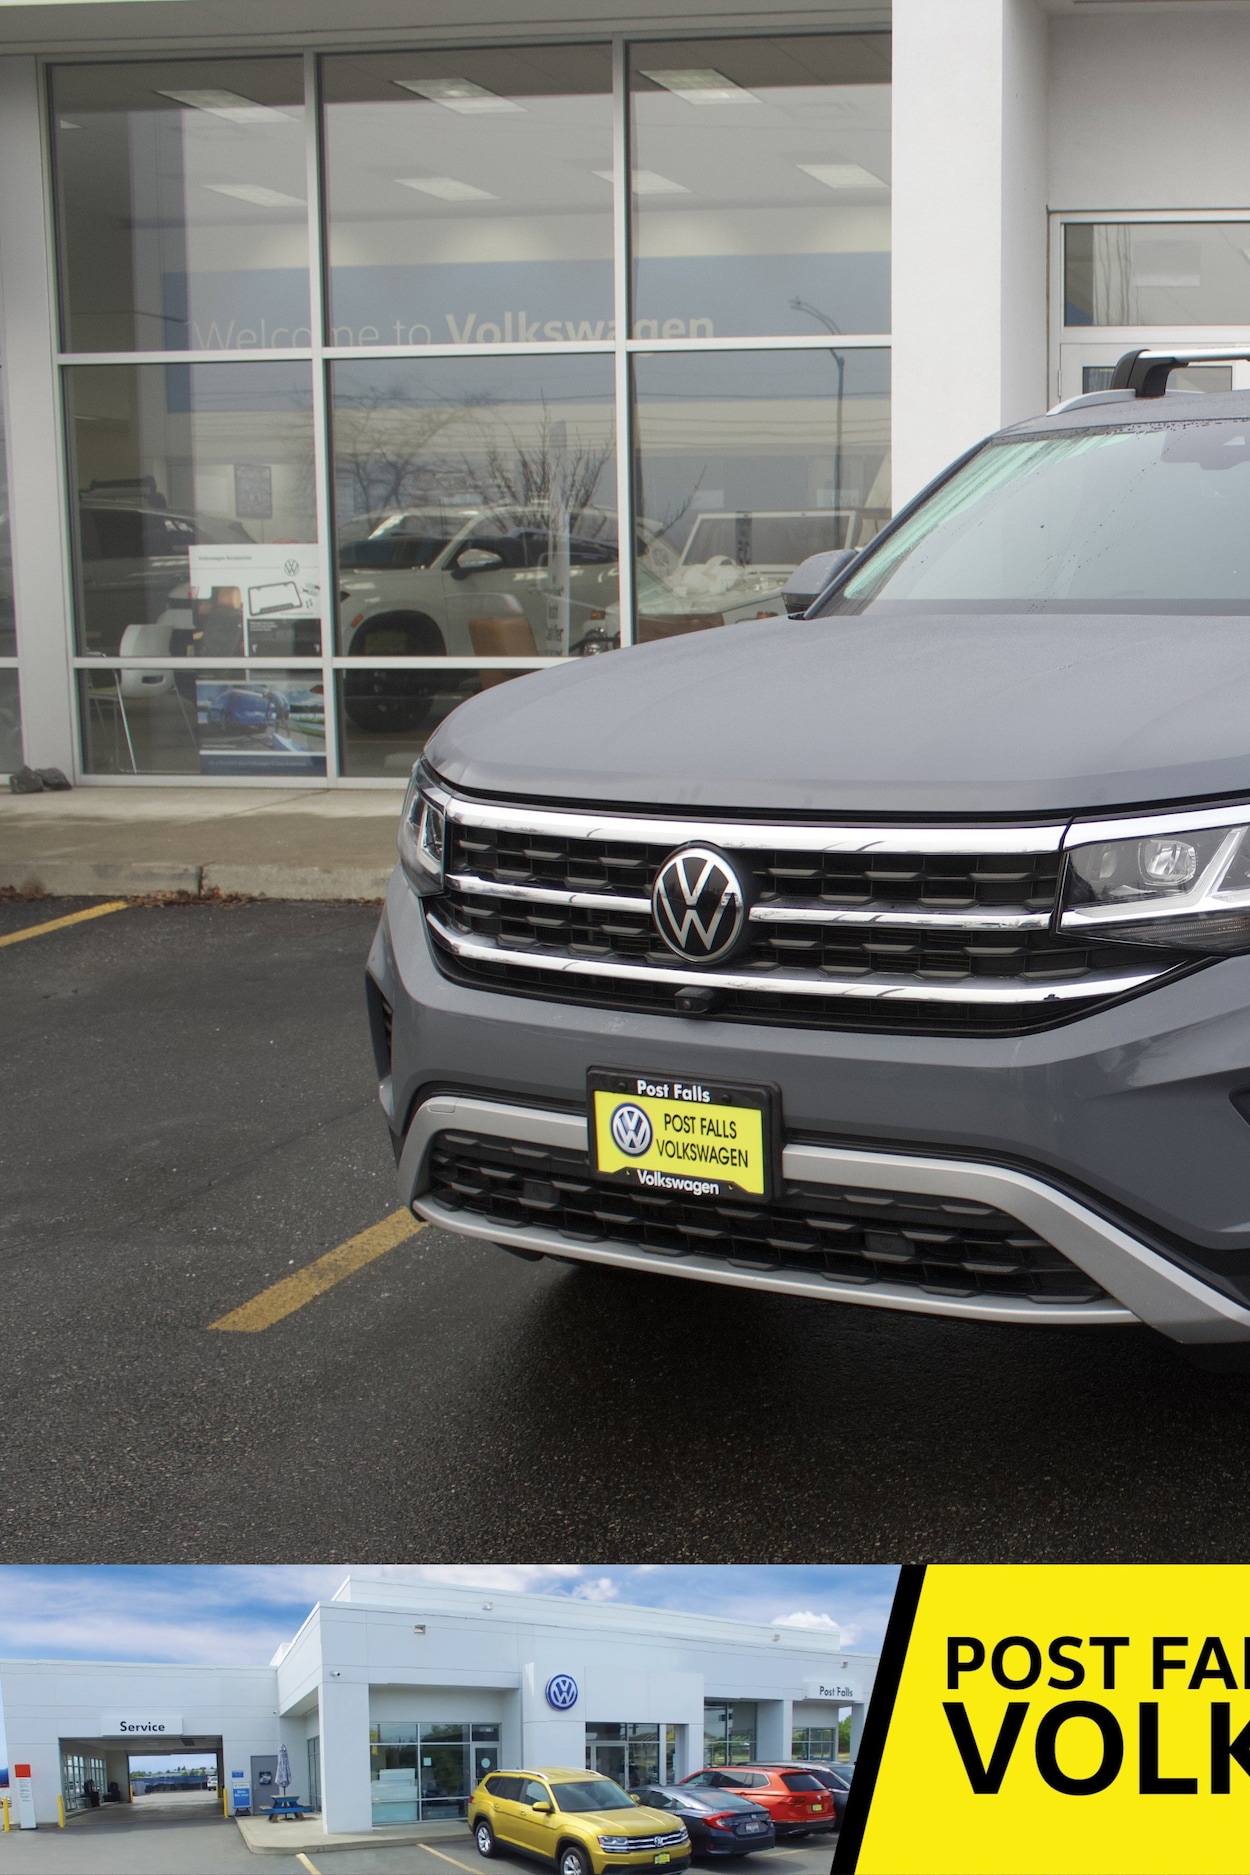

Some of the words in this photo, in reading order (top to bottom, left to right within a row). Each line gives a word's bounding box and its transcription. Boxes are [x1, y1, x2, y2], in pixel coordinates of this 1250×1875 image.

[393, 320, 431, 346] to
[637, 1080, 669, 1098] Post
[674, 1084, 710, 1103] Falls
[664, 1113, 696, 1134] POST
[700, 1118, 737, 1139] FALLS
[656, 1139, 748, 1168] VOLKSWAGEN
[637, 1169, 719, 1196] Volkswagen
